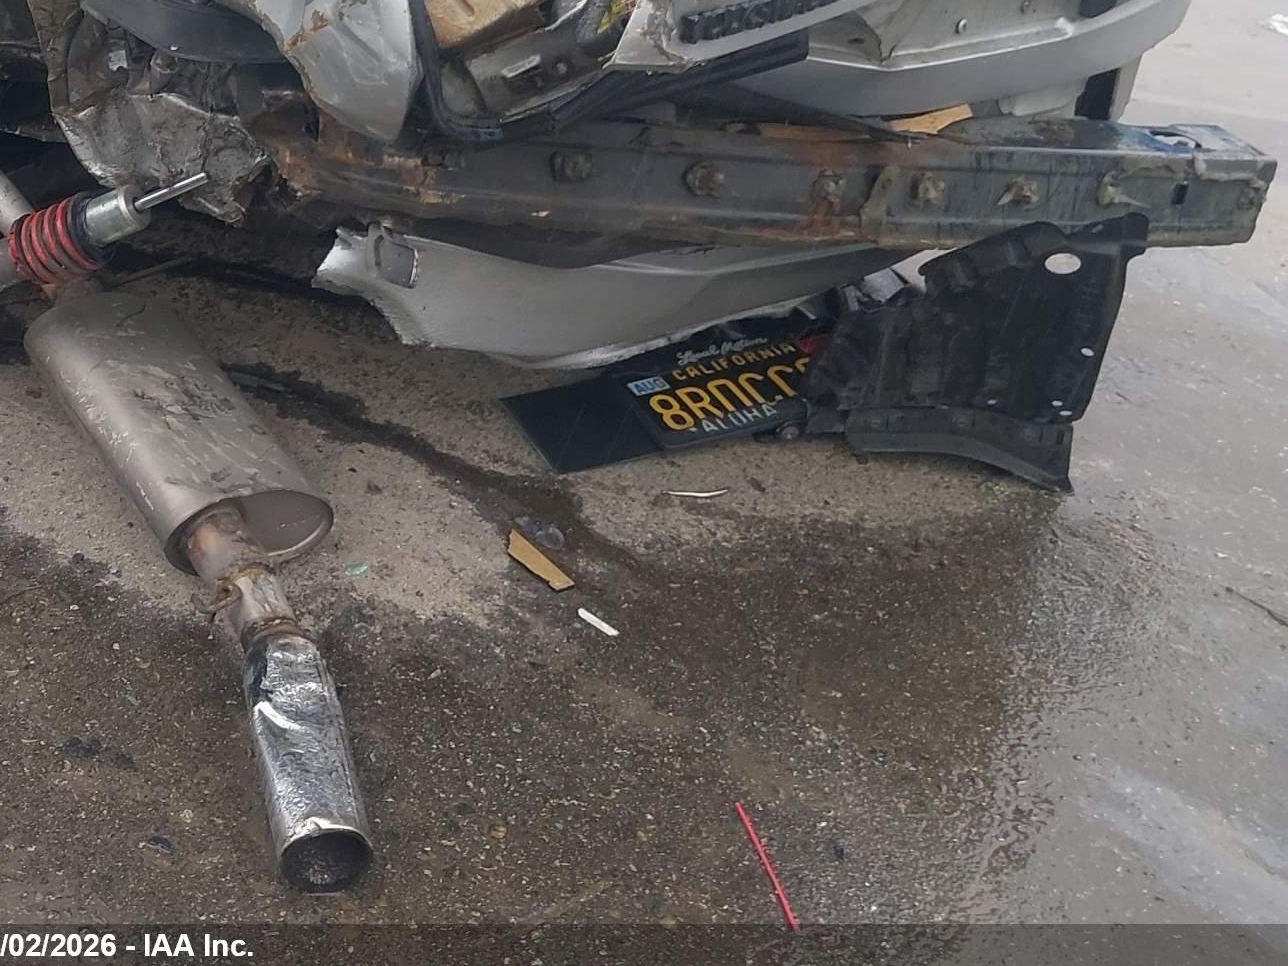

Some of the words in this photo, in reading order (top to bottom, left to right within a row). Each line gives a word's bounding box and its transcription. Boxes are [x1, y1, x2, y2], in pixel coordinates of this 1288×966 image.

[672, 343, 797, 381] CALIFORNIA
[634, 378, 666, 395] AUG
[701, 403, 778, 433] ALOHA
